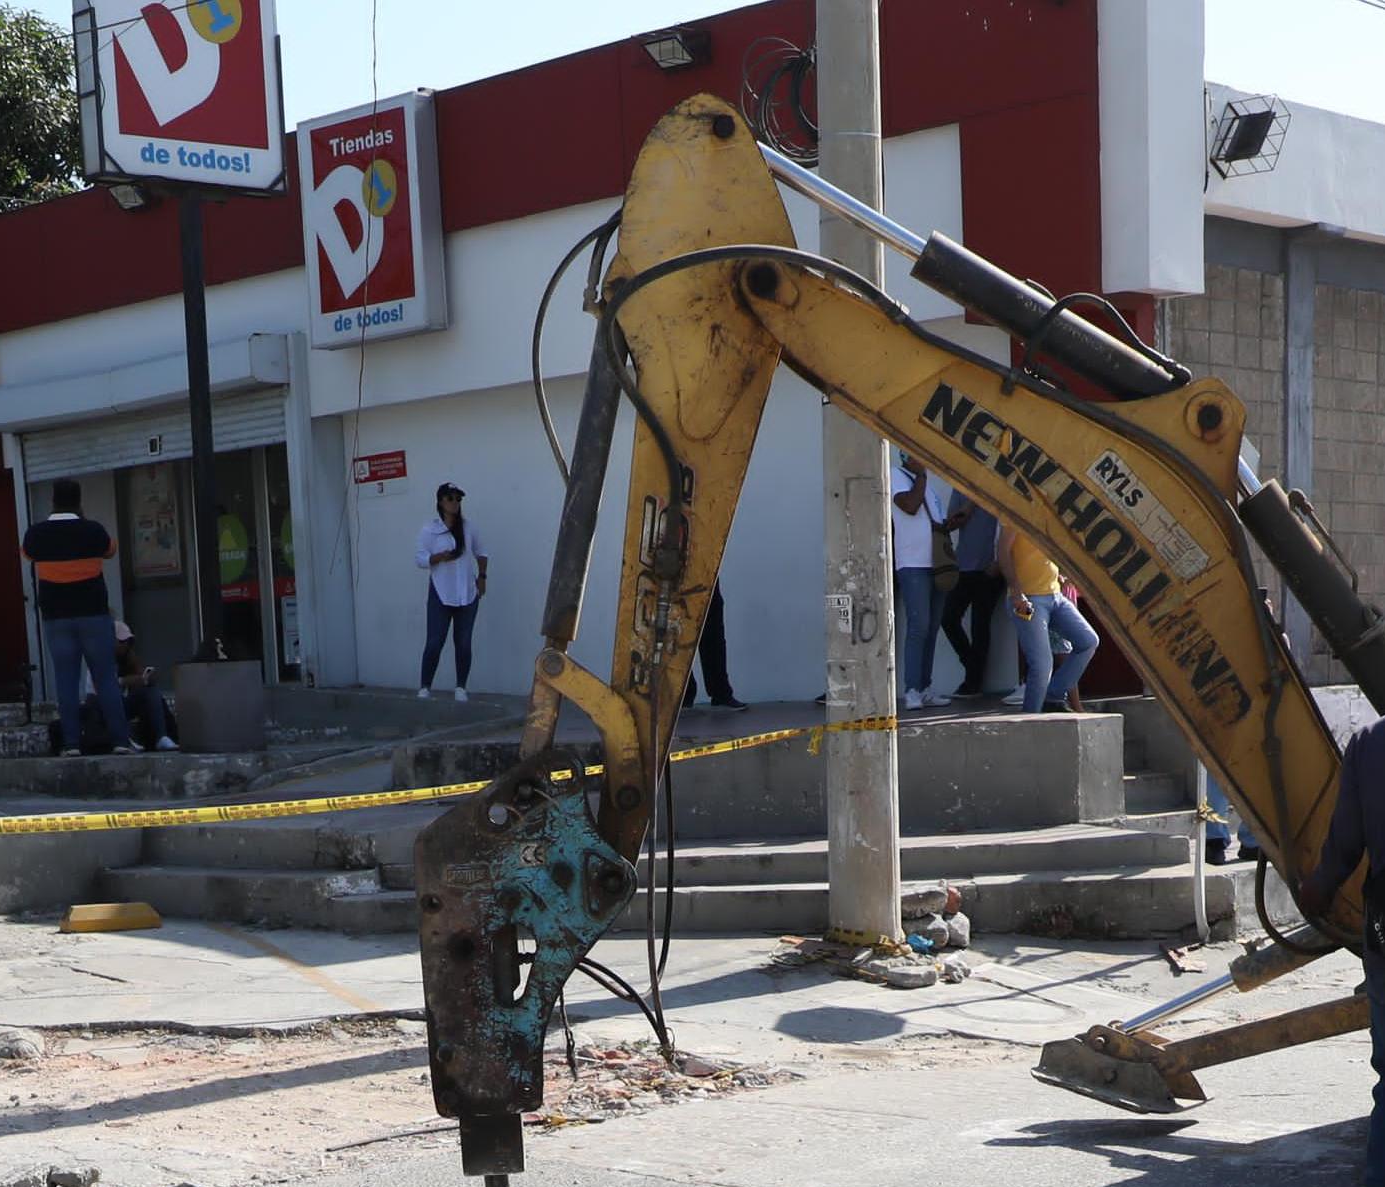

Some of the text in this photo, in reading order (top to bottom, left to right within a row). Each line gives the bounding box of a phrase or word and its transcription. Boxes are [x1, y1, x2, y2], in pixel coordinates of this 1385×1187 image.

[140, 142, 251, 173] de todos!
[328, 127, 394, 158] Tiendas
[334, 303, 404, 332] de todos!
[922, 382, 1057, 502] NEW
[1094, 456, 1144, 508] RYLS
